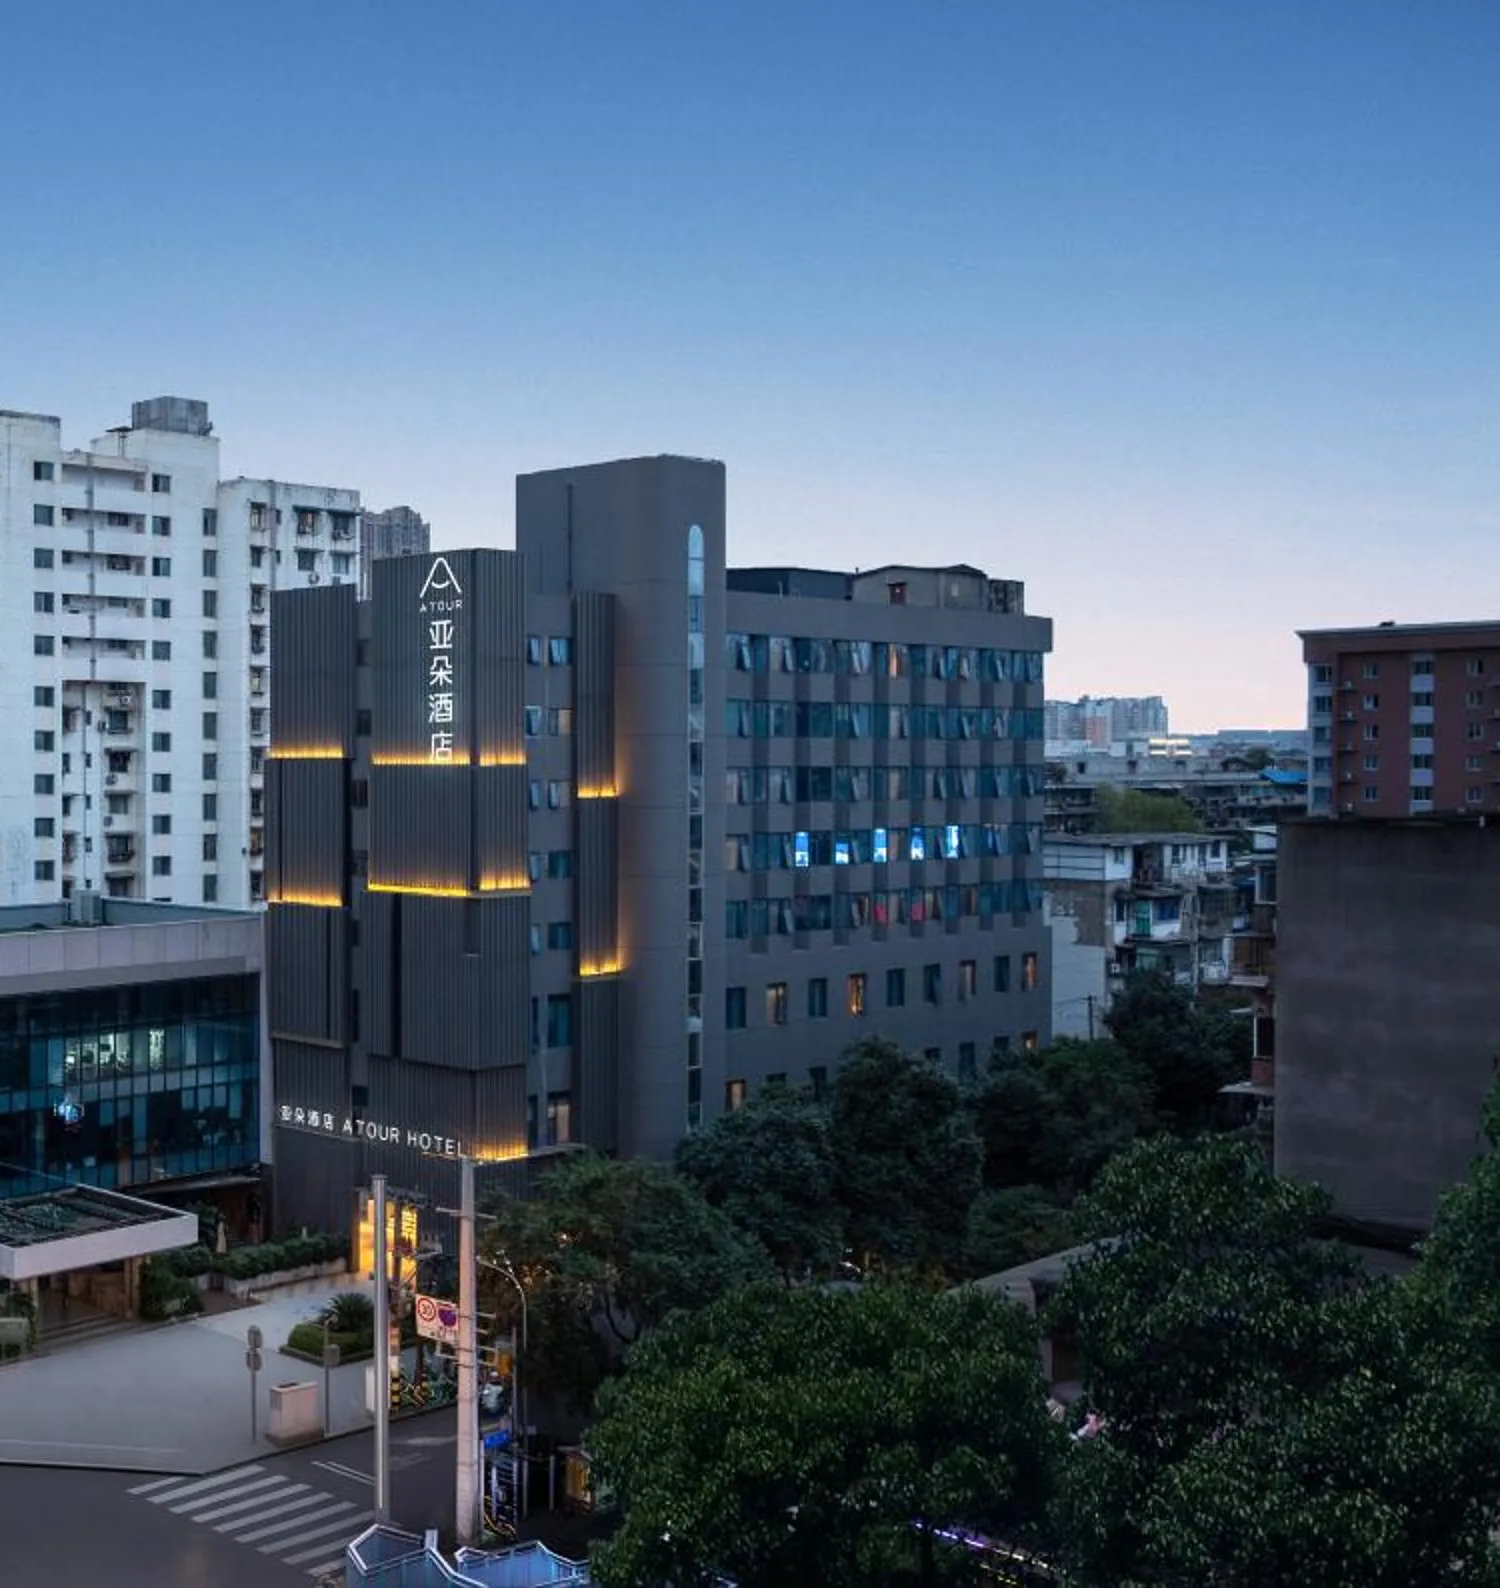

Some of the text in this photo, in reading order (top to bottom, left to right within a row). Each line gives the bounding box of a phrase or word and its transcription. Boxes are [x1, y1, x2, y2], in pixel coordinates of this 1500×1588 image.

[419, 599, 463, 613] ATOUR
[428, 619, 454, 763] 亚朵酒店
[342, 1118, 467, 1157] ATOUR HOTEL
